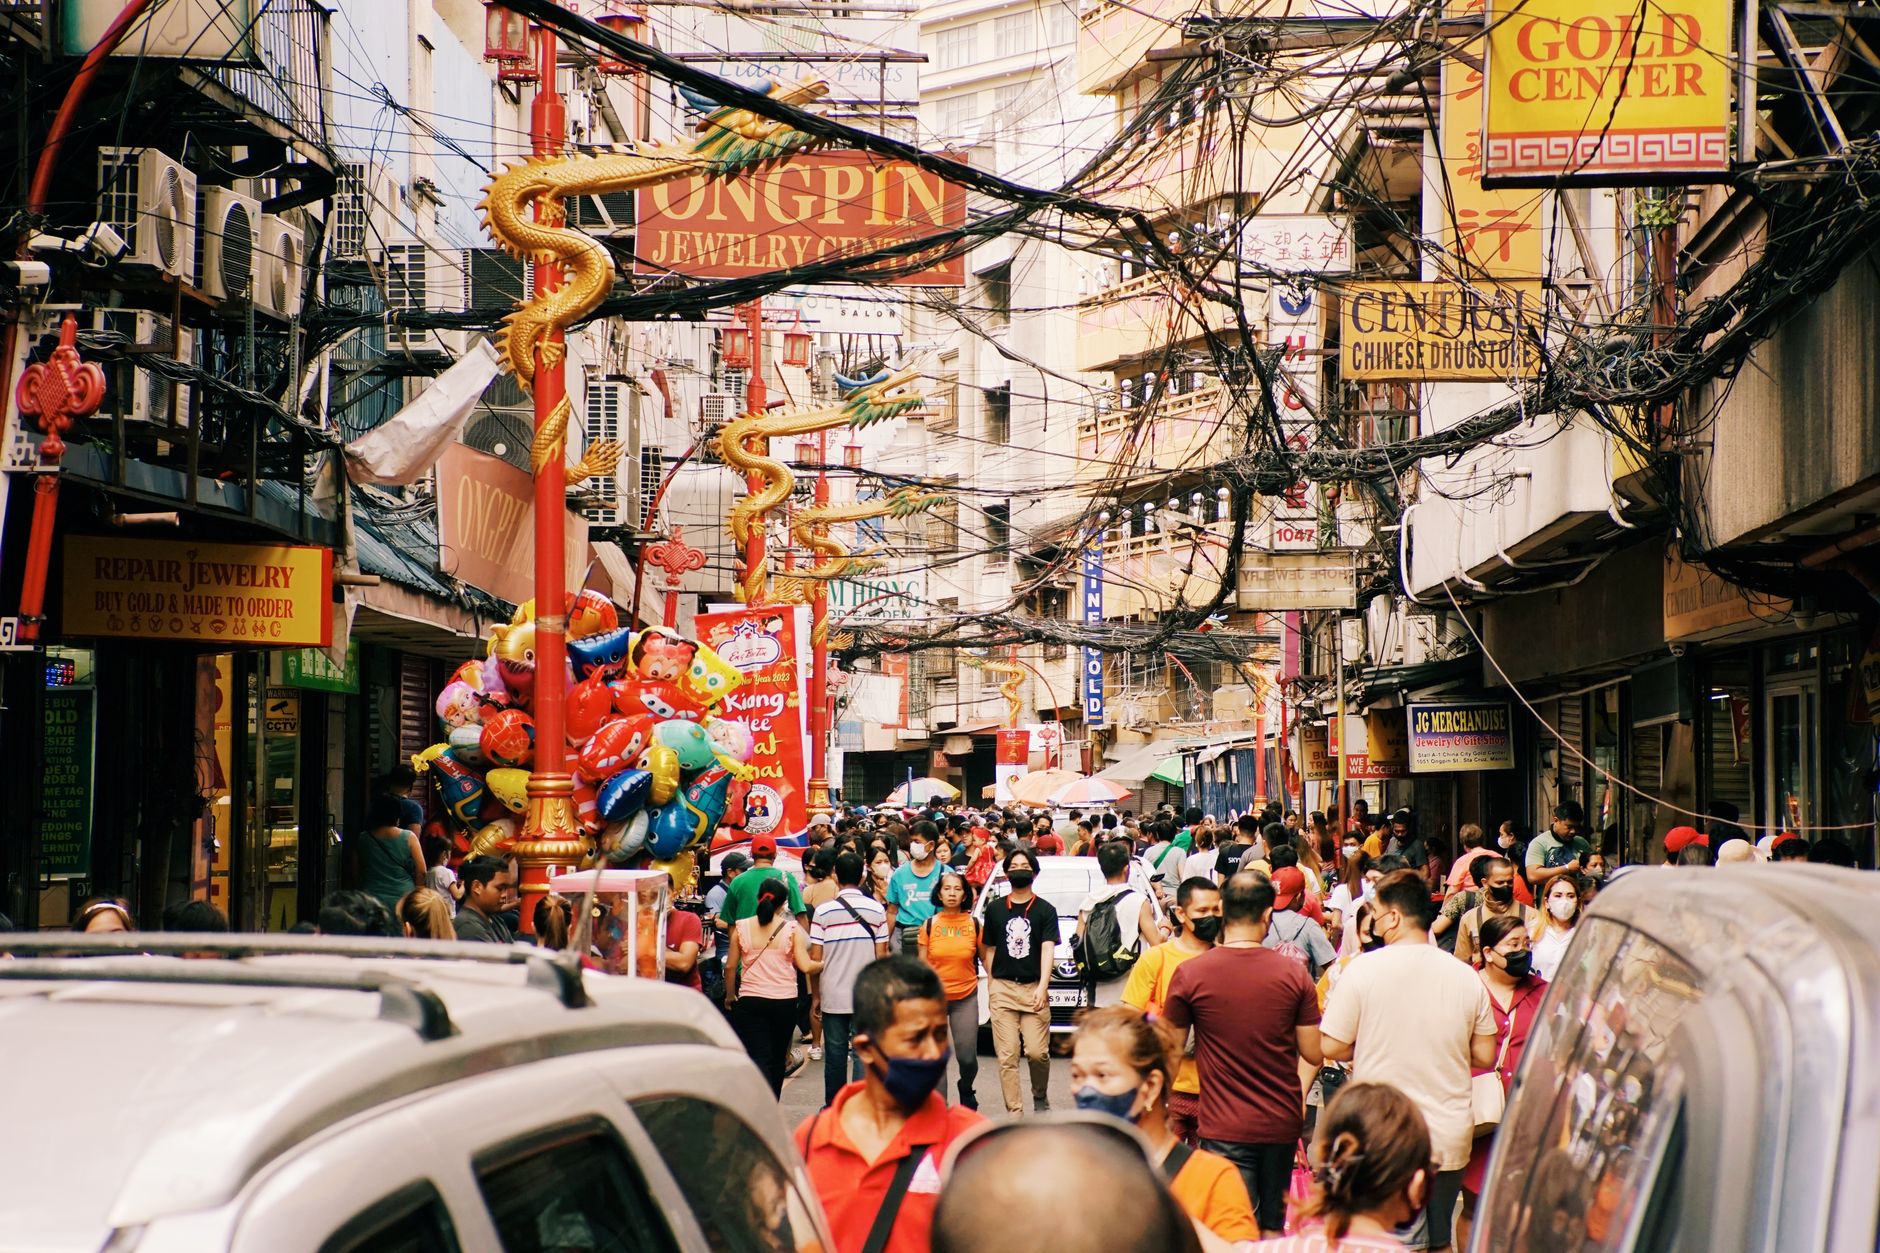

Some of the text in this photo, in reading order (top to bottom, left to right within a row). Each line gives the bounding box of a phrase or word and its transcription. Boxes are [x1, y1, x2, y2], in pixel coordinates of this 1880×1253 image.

[1517, 12, 1702, 63] GOLD
[836, 62, 903, 82] PARIS
[1508, 62, 1707, 103] CENTER
[652, 163, 946, 227] ONGPIN
[652, 230, 818, 268] JEWELRY
[841, 309, 896, 318] SALON
[1350, 289, 1534, 334] CENTRAL
[1352, 341, 1532, 371] CHINESE DRUGSTORE
[1276, 528, 1315, 543] 1047
[94, 556, 182, 583] REPAIR
[853, 580, 920, 608] HIONG
[95, 591, 294, 619] BUY GOLD & MADE TO ORDER
[754, 674, 771, 685] Year
[772, 672, 790, 682] 2023
[266, 689, 298, 698] WARNING
[54, 697, 76, 707] BUY
[266, 721, 297, 732] CCTV
[1416, 711, 1429, 733] JG
[1431, 708, 1506, 732] MERCHANDISE
[1416, 736, 1451, 748] Jewelry
[1453, 735, 1461, 746] &
[1463, 735, 1481, 746] Gift
[1482, 734, 1505, 747] Shop
[65, 764, 79, 773] TO
[1349, 758, 1365, 766] WE
[1349, 766, 1364, 774] WE
[1366, 766, 1402, 774] ACCEPT
[64, 787, 84, 796] TAG
[935, 924, 974, 937] SUMMER
